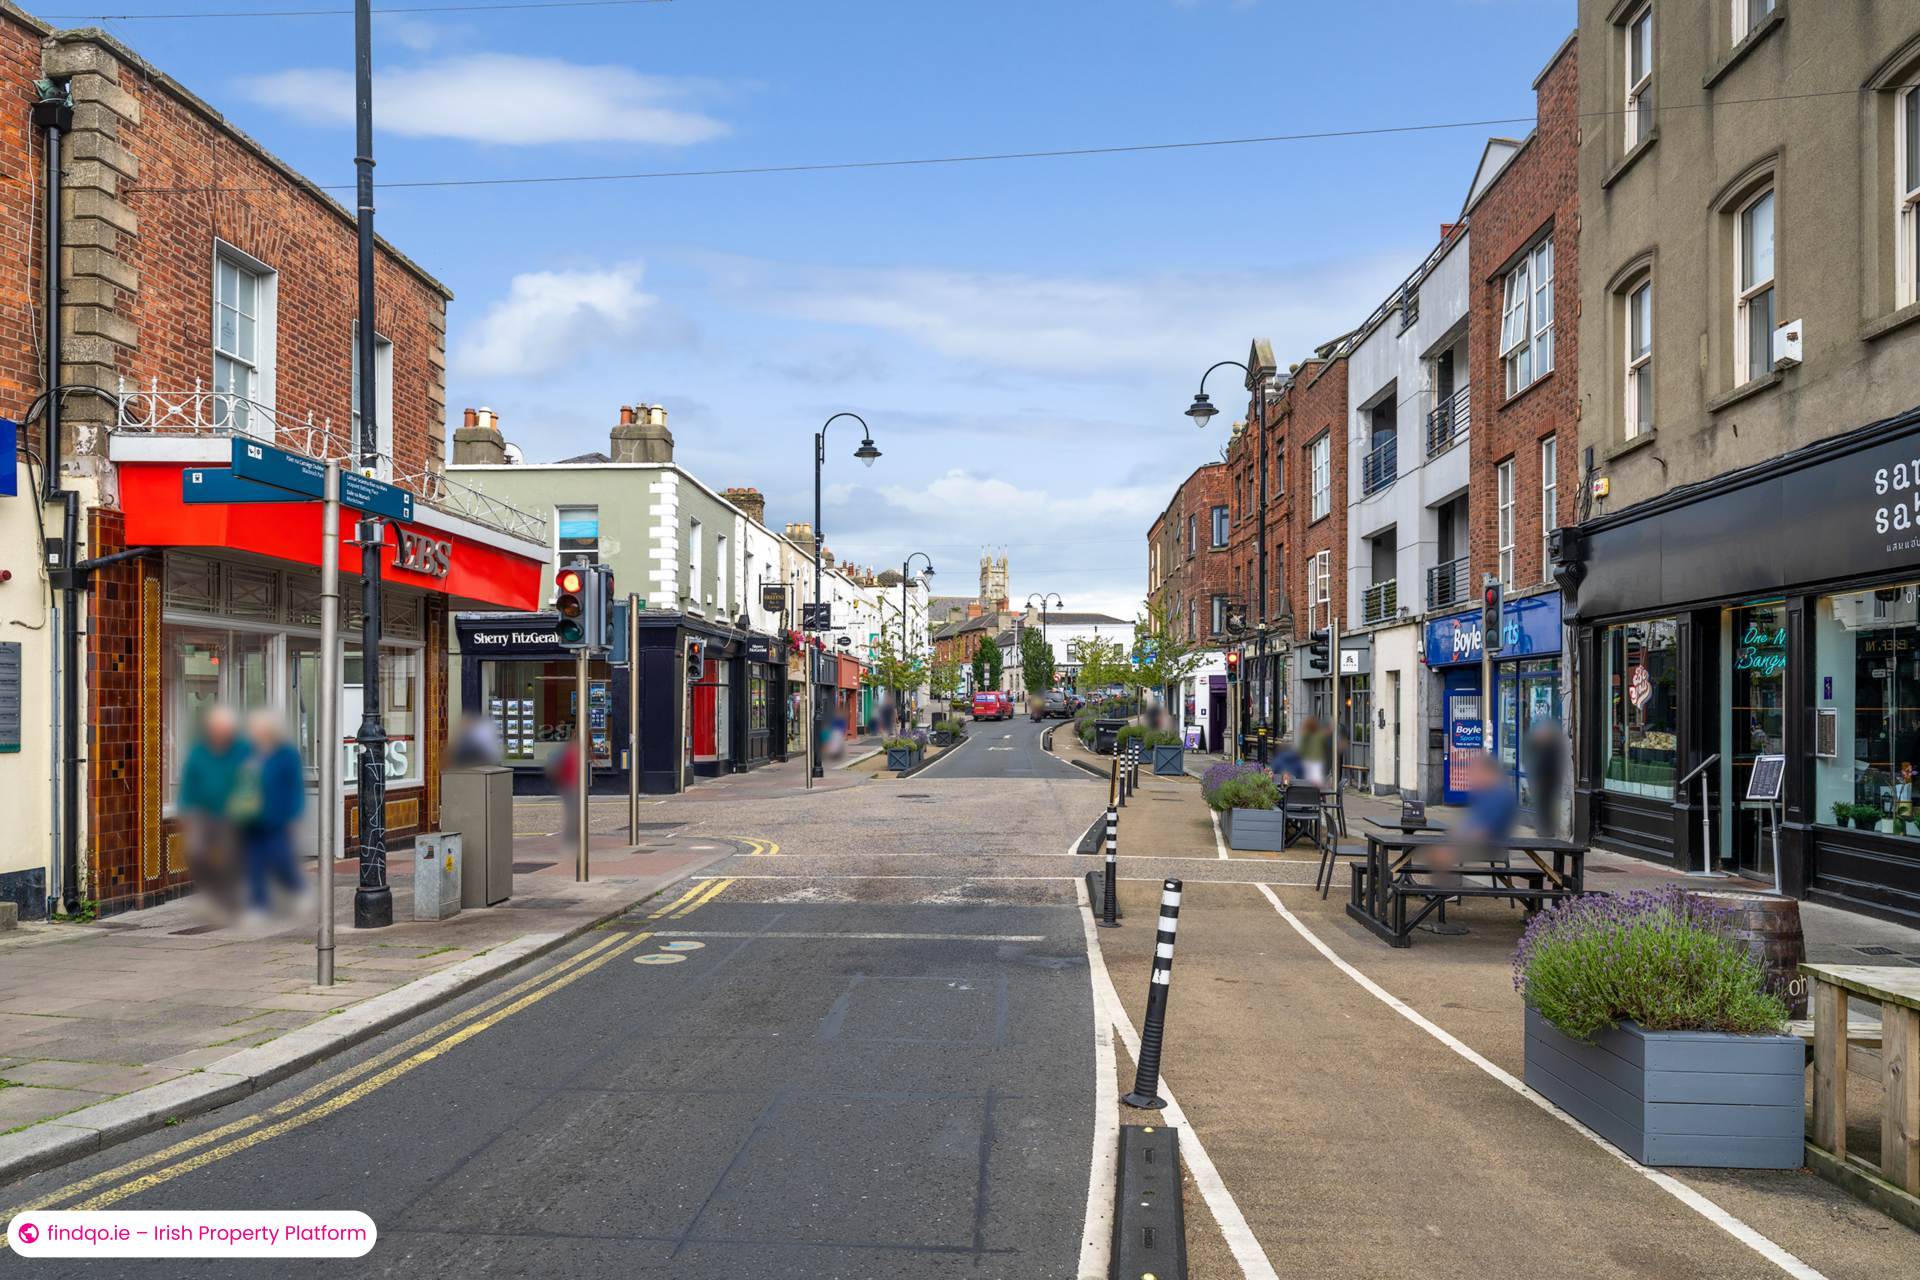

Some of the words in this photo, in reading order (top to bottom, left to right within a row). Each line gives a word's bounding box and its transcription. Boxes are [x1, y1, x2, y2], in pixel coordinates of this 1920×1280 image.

[391, 529, 452, 577] EBS
[473, 632, 509, 647] Sherry
[511, 632, 560, 644] FitzGeral
[1744, 626, 1768, 644] One
[1456, 725, 1482, 735] Boyle
